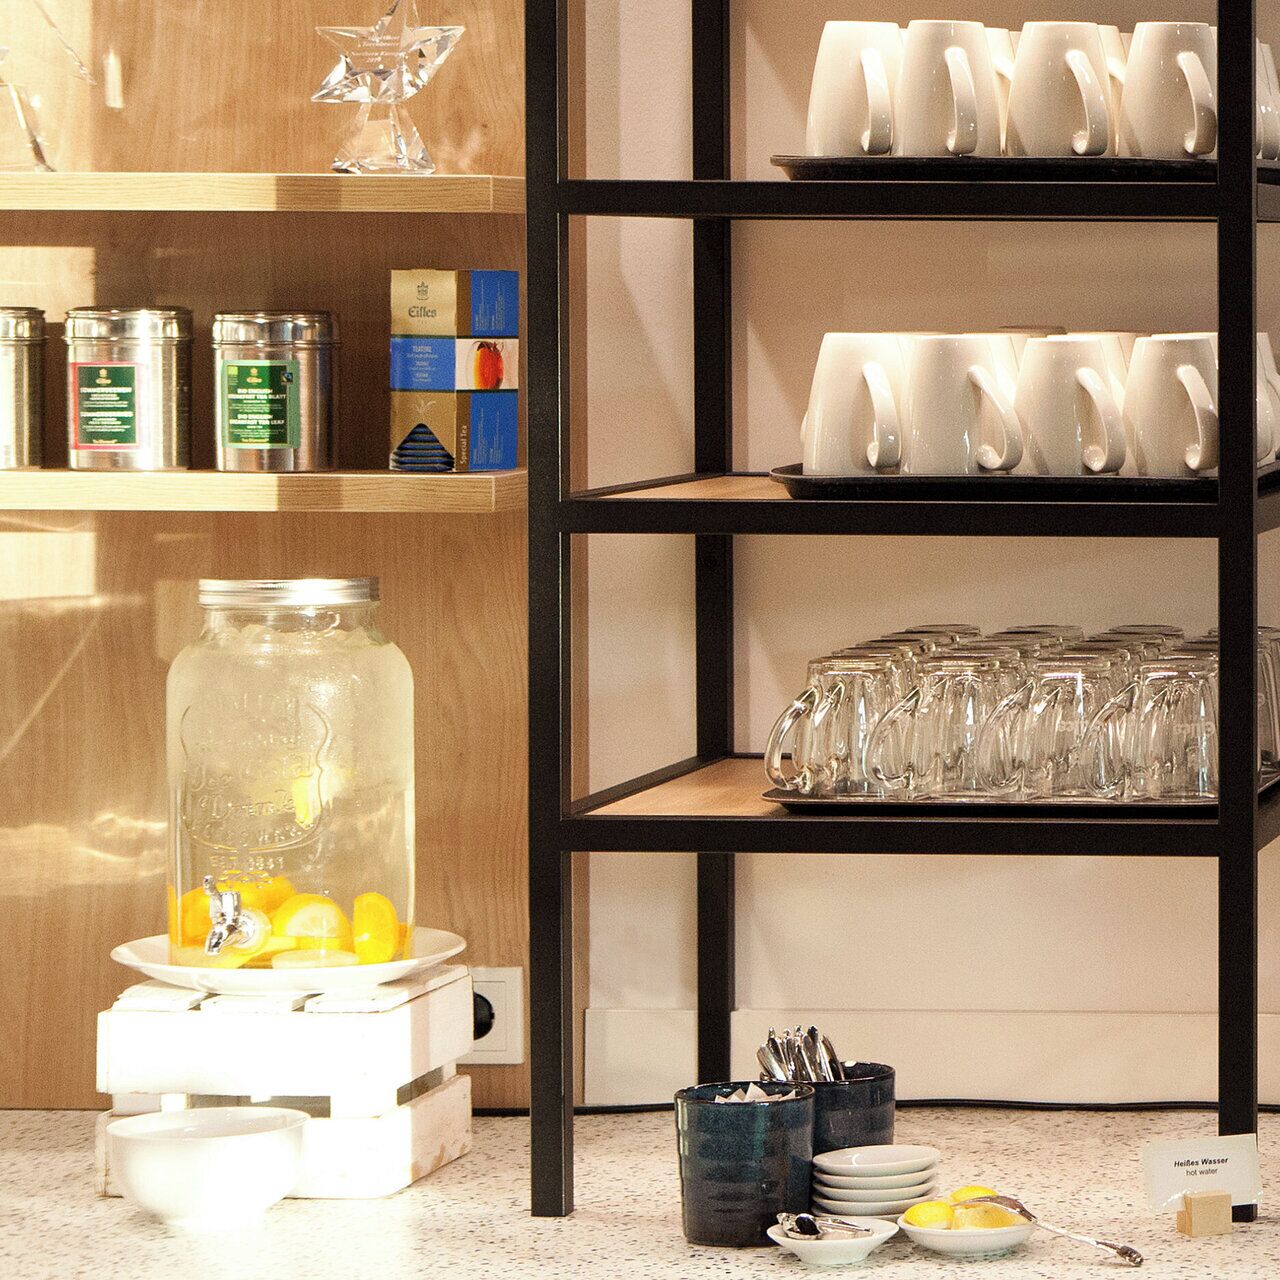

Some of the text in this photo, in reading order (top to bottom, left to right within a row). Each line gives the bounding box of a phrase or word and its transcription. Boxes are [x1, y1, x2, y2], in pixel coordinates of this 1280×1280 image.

[1174, 1157, 1229, 1168] Heißes Wasser
[1186, 1167, 1218, 1176] hot water
